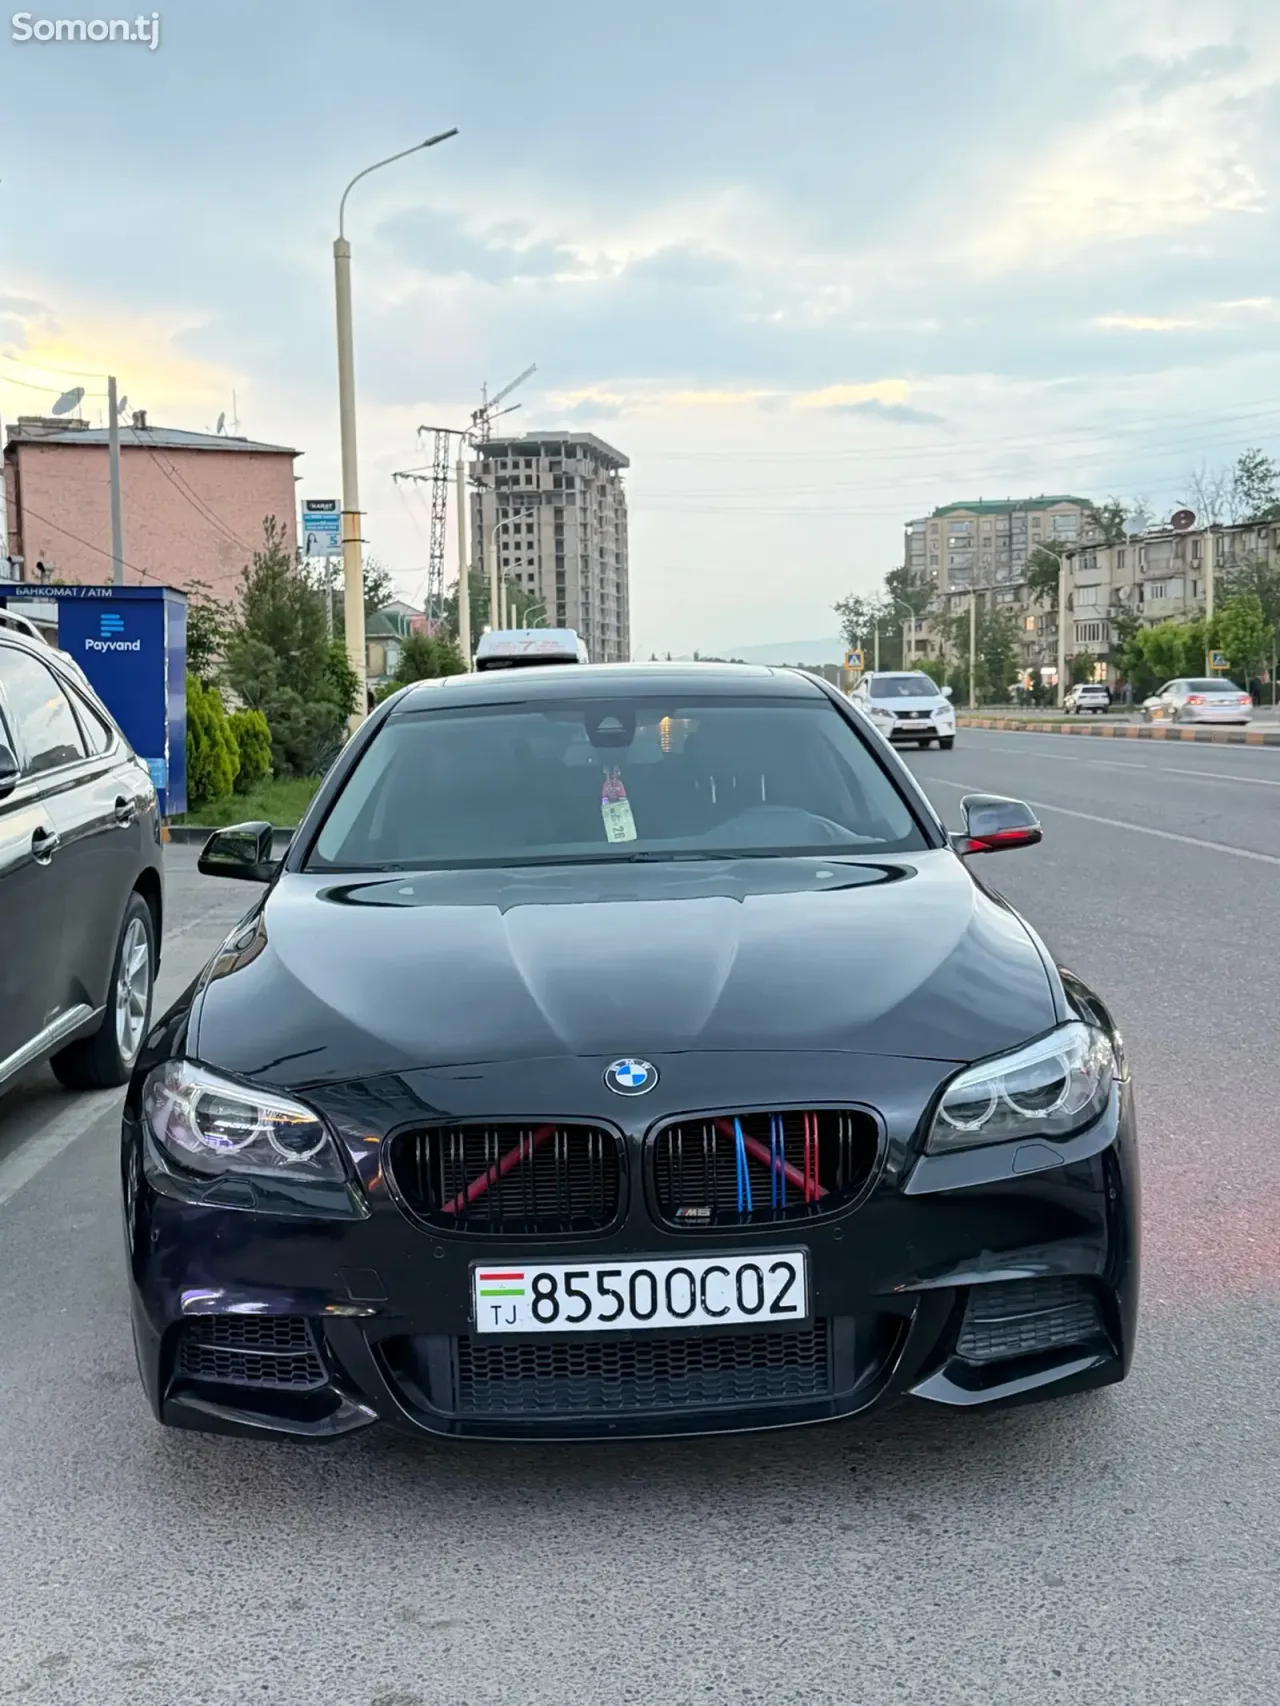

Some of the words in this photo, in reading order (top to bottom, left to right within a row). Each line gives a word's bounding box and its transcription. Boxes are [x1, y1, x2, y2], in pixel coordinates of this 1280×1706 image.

[16, 587, 77, 596] БАНКОМАТ
[88, 588, 112, 597] ATM
[85, 639, 140, 653] Payvand
[490, 1304, 517, 1325] TJ
